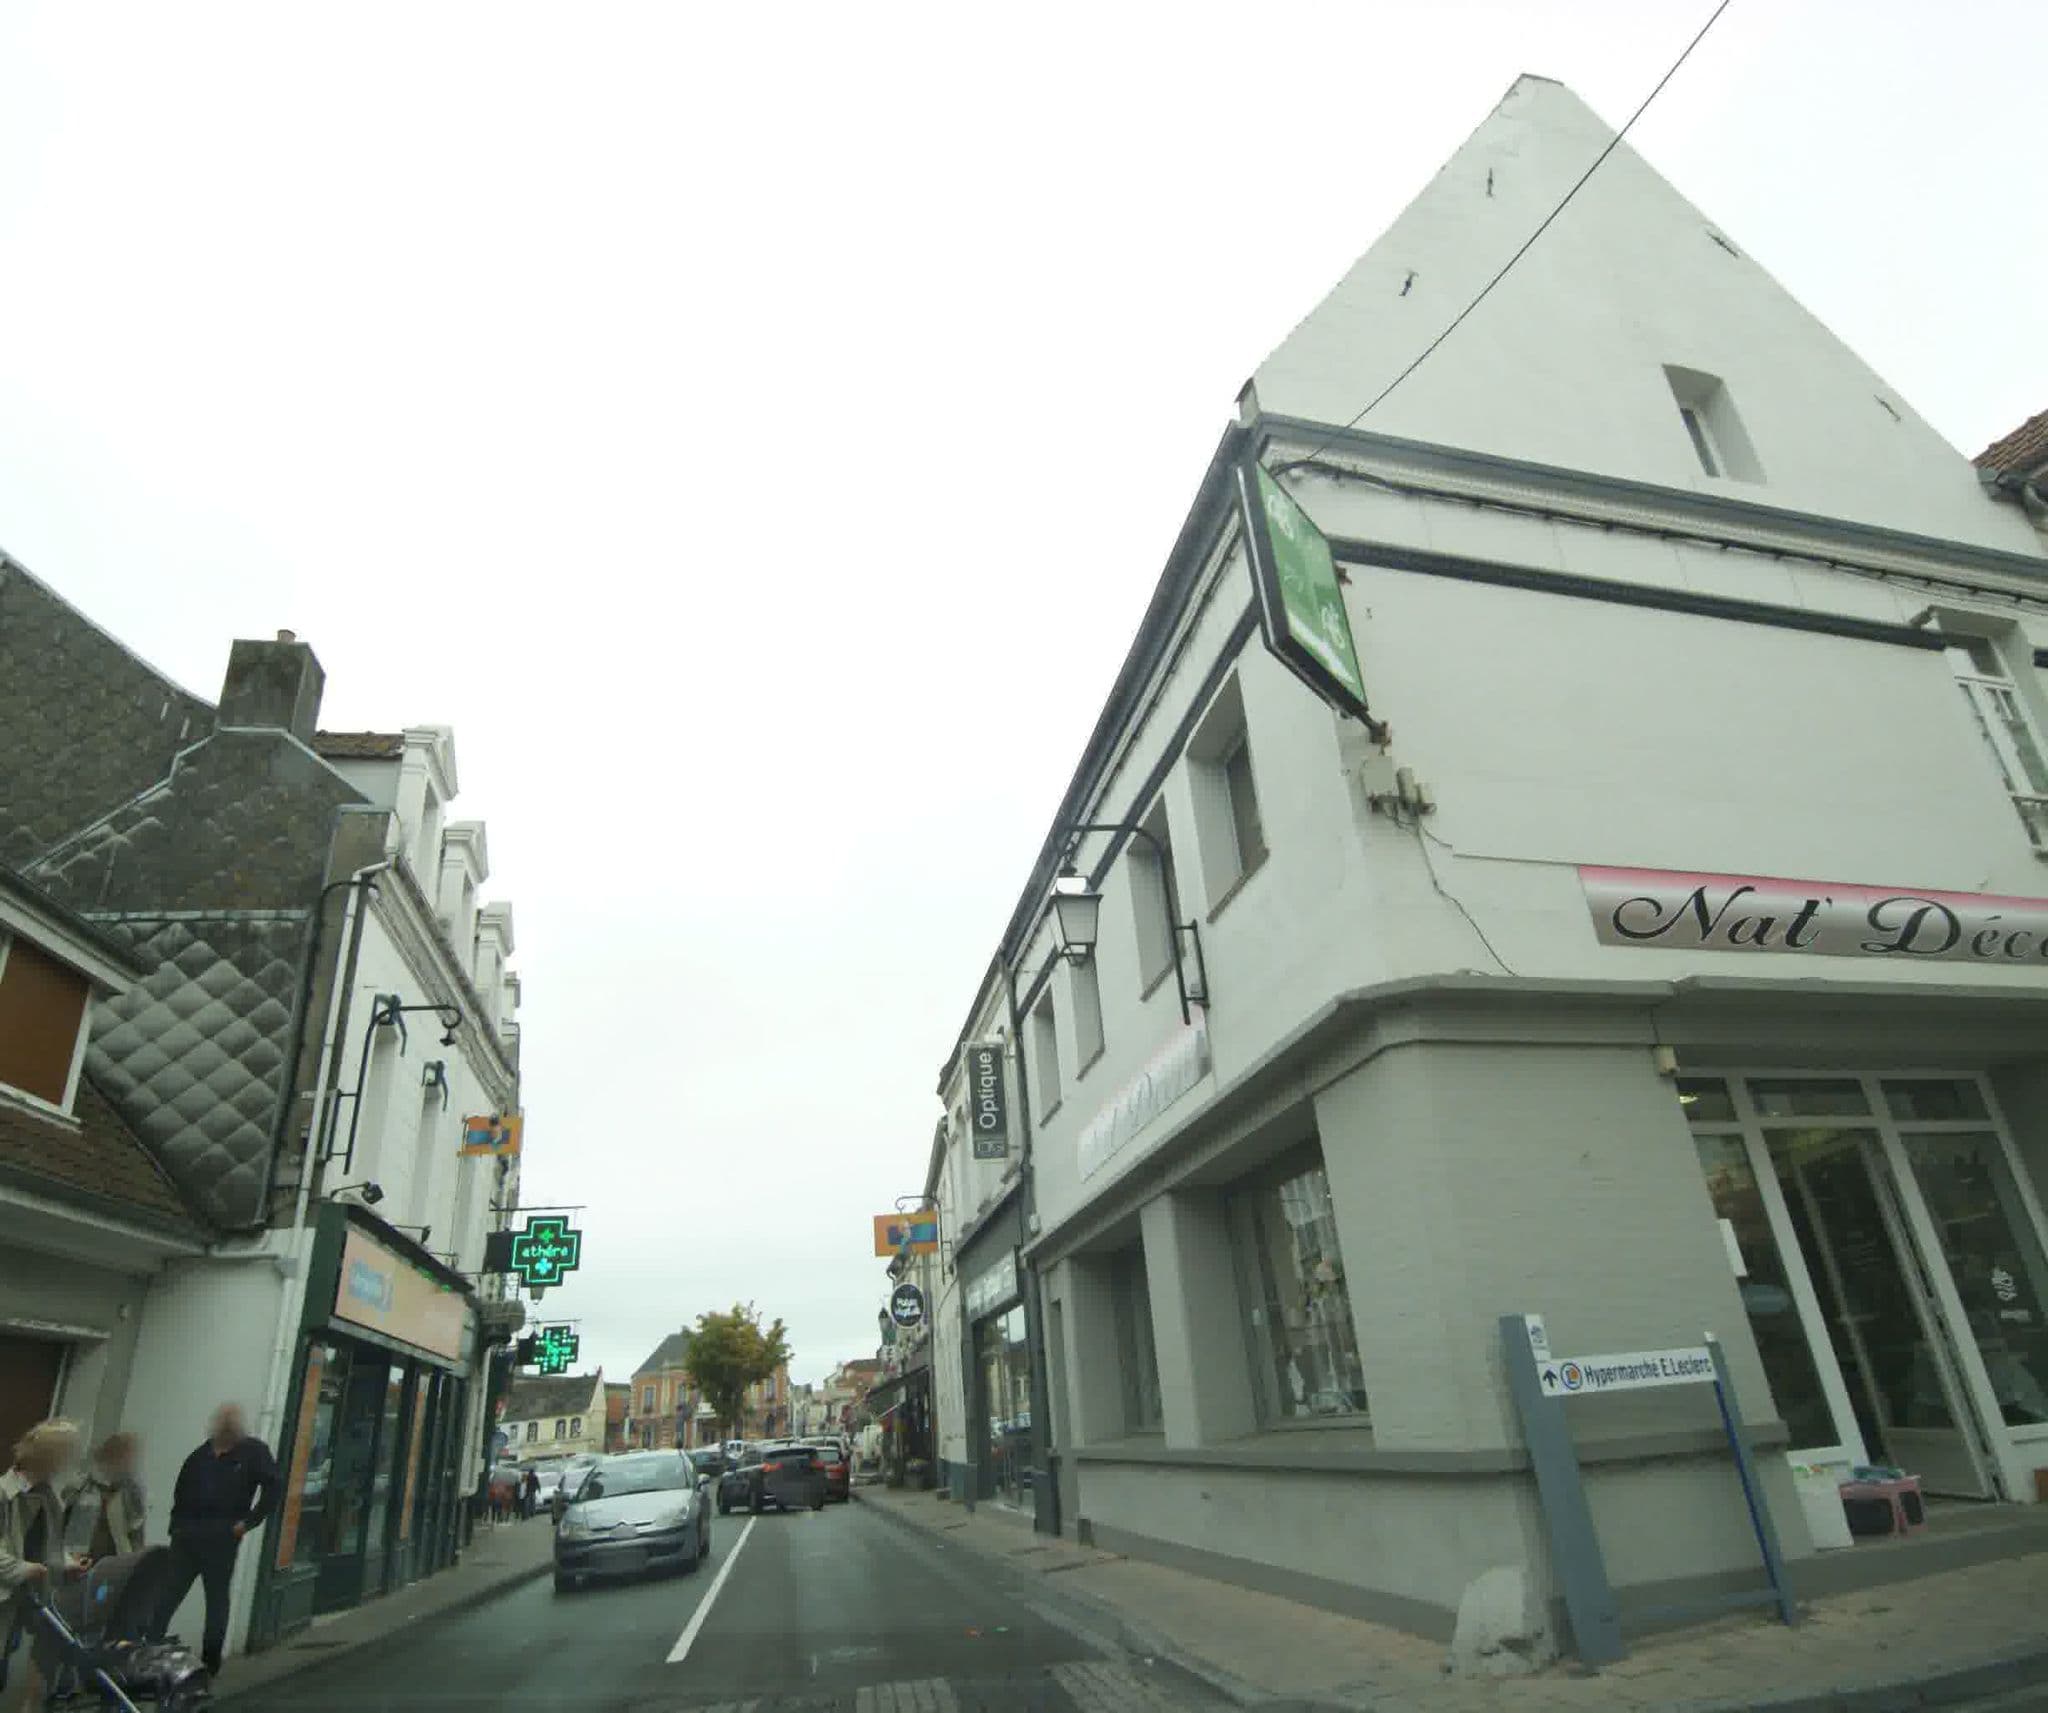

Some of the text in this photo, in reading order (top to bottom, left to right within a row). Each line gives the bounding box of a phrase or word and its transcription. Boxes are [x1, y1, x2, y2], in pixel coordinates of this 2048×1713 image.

[1860, 896, 2048, 960] Déc
[978, 1050, 1001, 1129] Optique
[1584, 1355, 1712, 1387] Hypermarché E.Leclerc
